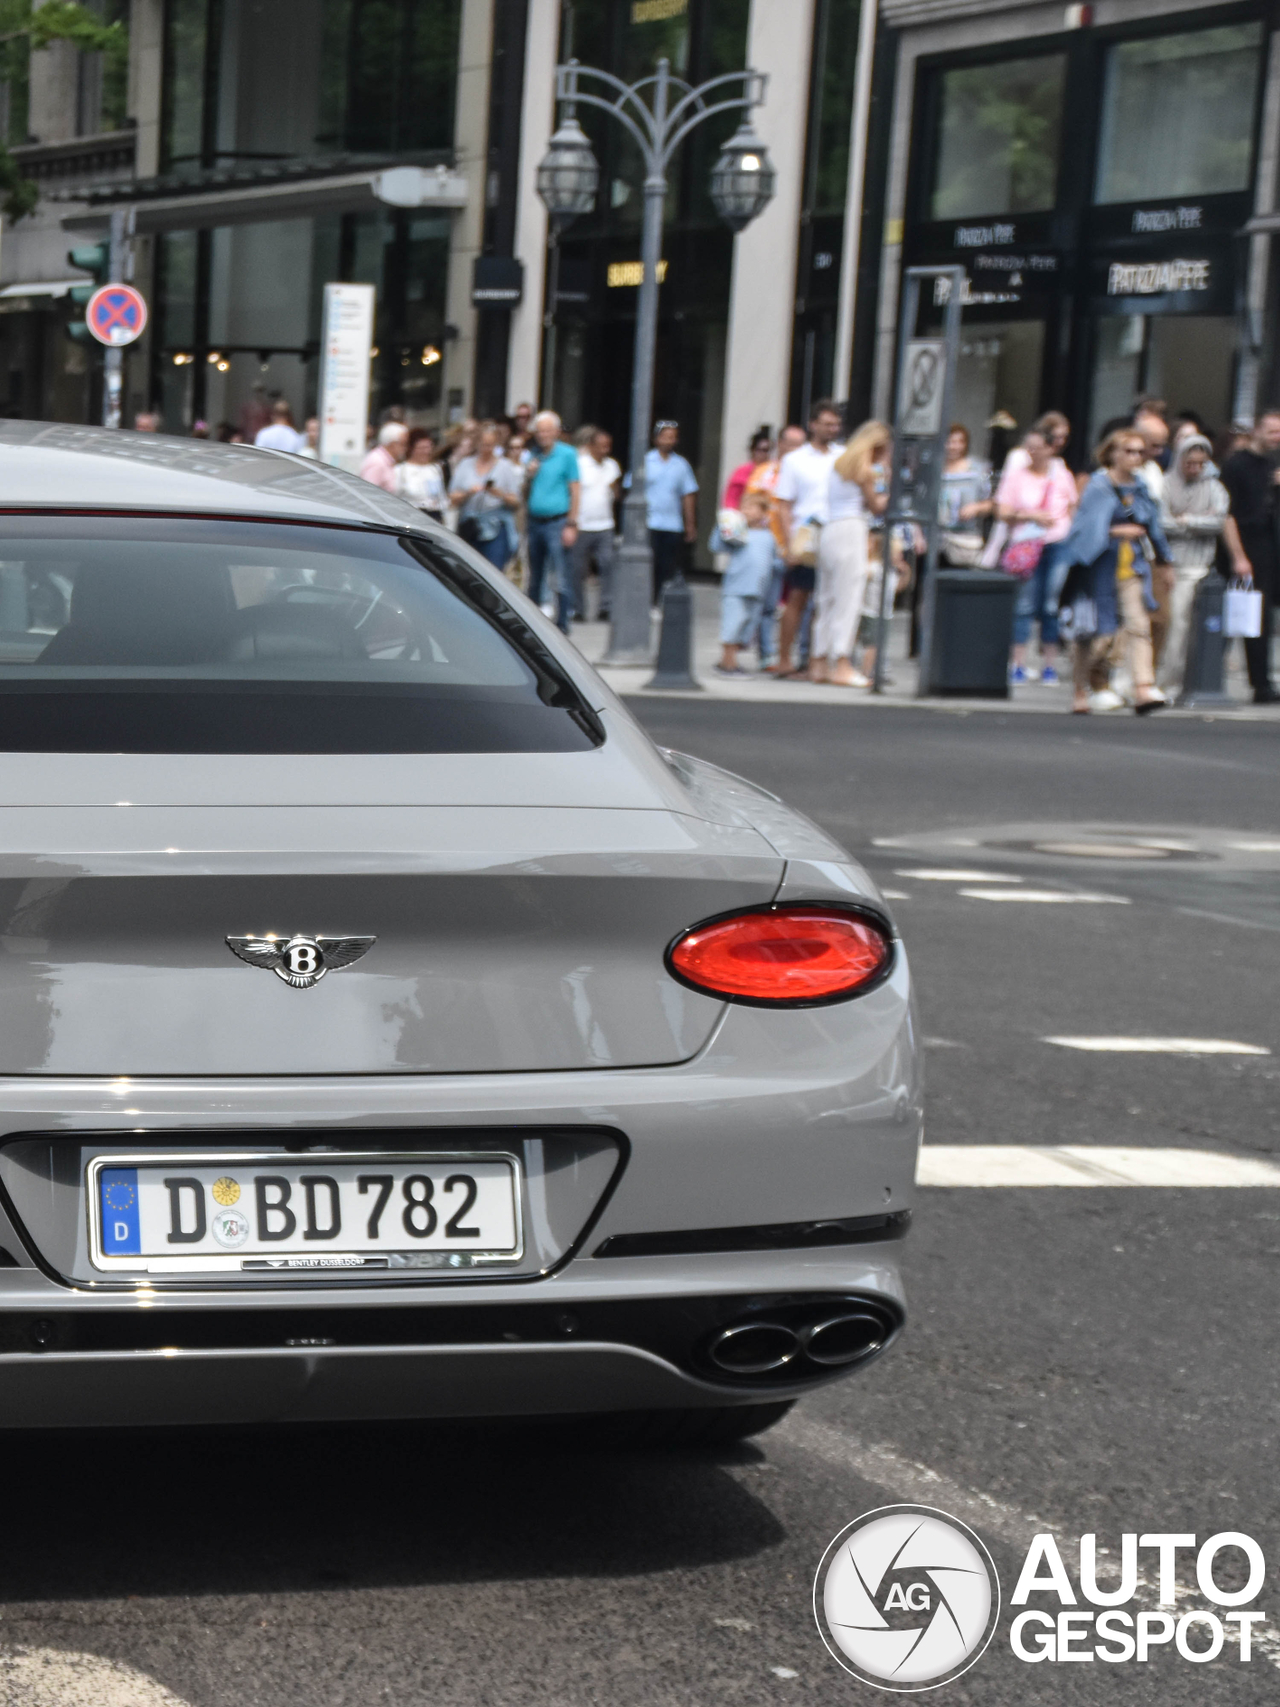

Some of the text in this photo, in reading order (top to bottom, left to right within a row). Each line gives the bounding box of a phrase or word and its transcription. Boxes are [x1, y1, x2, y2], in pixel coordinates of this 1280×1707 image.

[290, 946, 317, 973] B
[164, 1177, 207, 1243] D
[254, 1175, 342, 1241] BD
[358, 1174, 480, 1240] 782
[114, 1221, 129, 1241] D
[288, 1259, 319, 1267] BENTLEY
